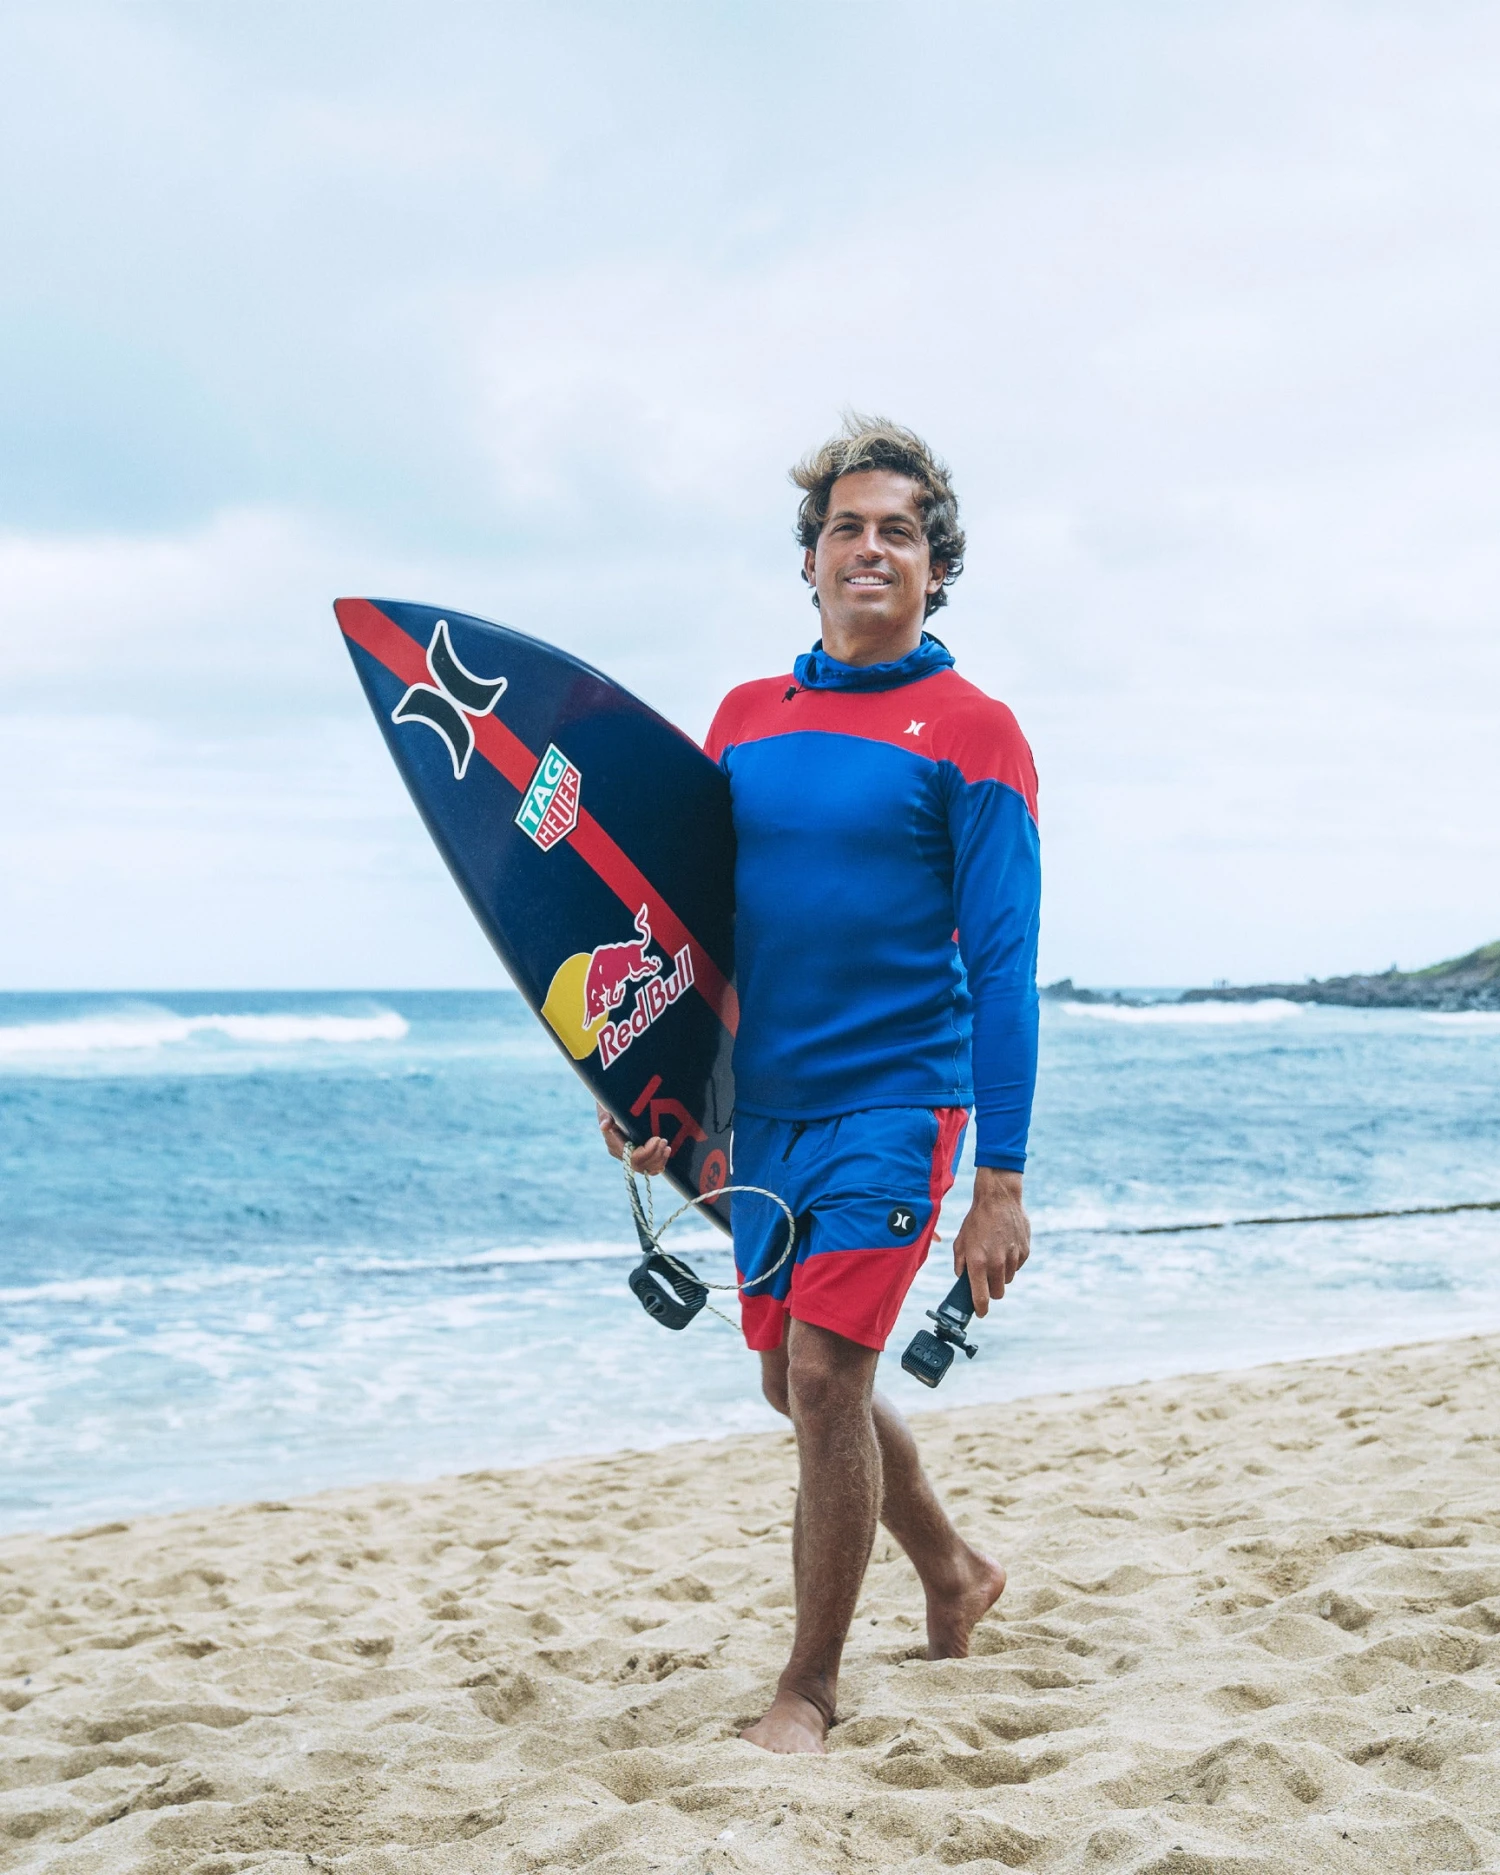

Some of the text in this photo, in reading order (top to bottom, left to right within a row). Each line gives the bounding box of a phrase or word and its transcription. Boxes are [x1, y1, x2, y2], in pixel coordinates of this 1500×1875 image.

[521, 755, 564, 825] TAG
[538, 771, 577, 844] HEUER
[598, 946, 695, 1068] Red Bull
